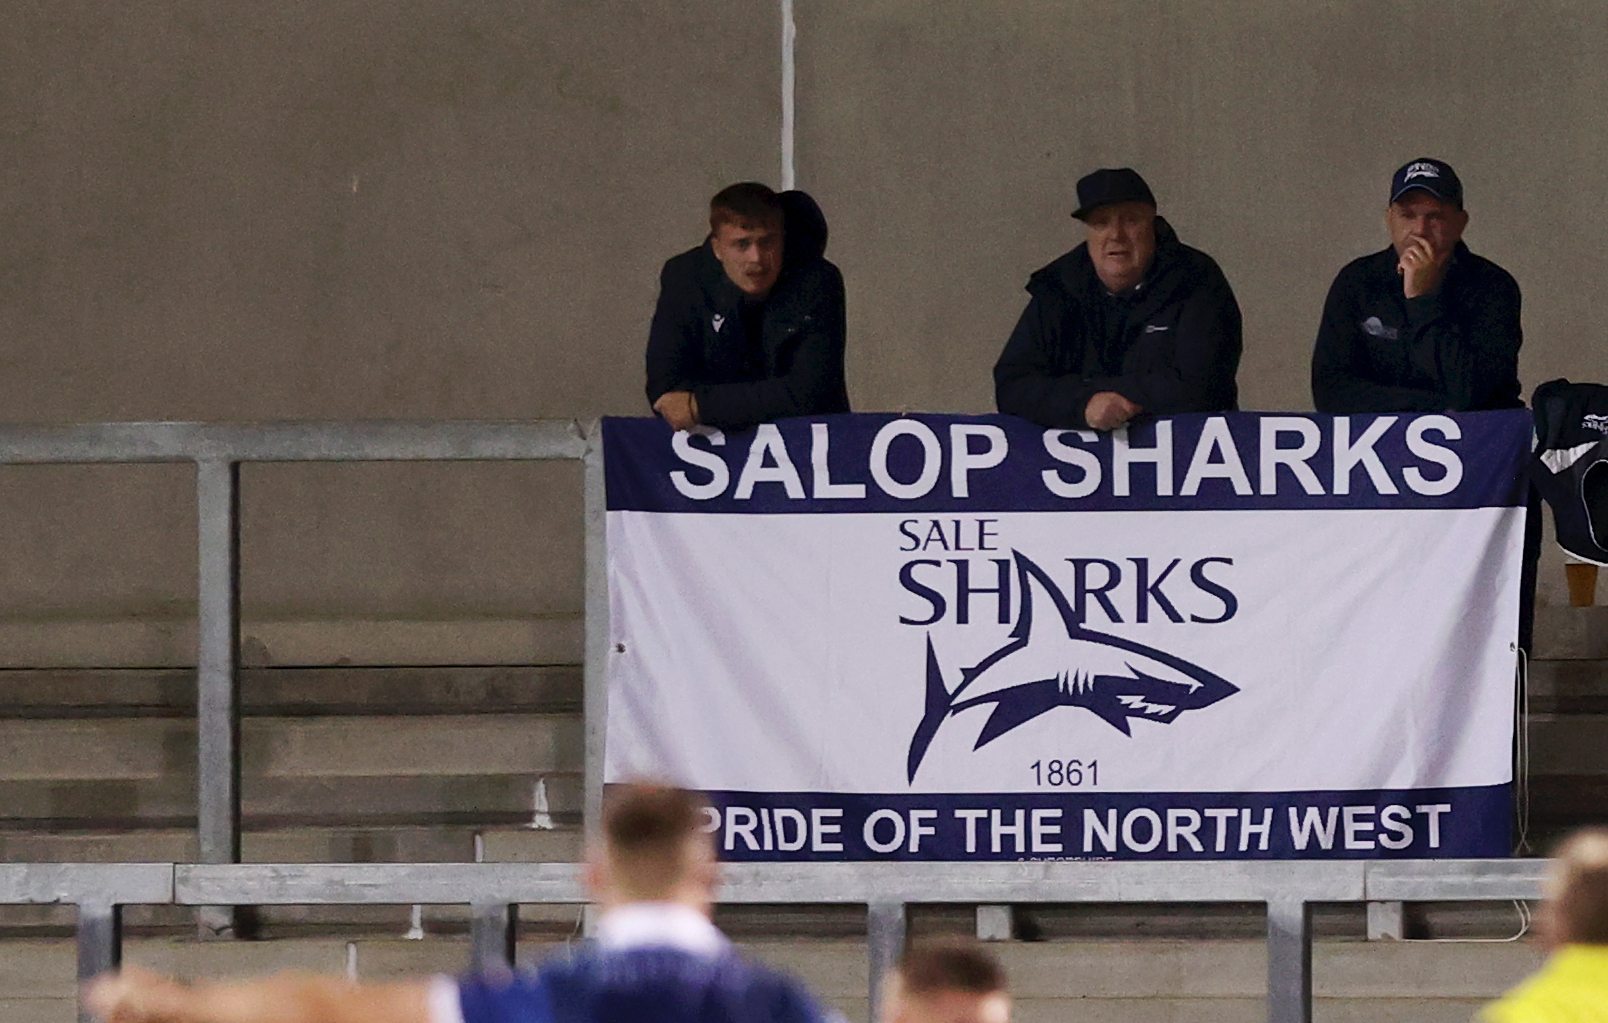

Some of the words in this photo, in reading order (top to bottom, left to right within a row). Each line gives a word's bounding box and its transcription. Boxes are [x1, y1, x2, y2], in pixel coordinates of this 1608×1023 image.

[670, 419, 1009, 500] SALOP
[1041, 414, 1463, 498] SHARKS
[899, 519, 999, 551] SALE
[1030, 759, 1099, 786] 1861
[862, 808, 938, 853] OF
[953, 808, 1063, 853] THE
[1082, 807, 1274, 852] NORTH
[1288, 804, 1452, 850] WEST
